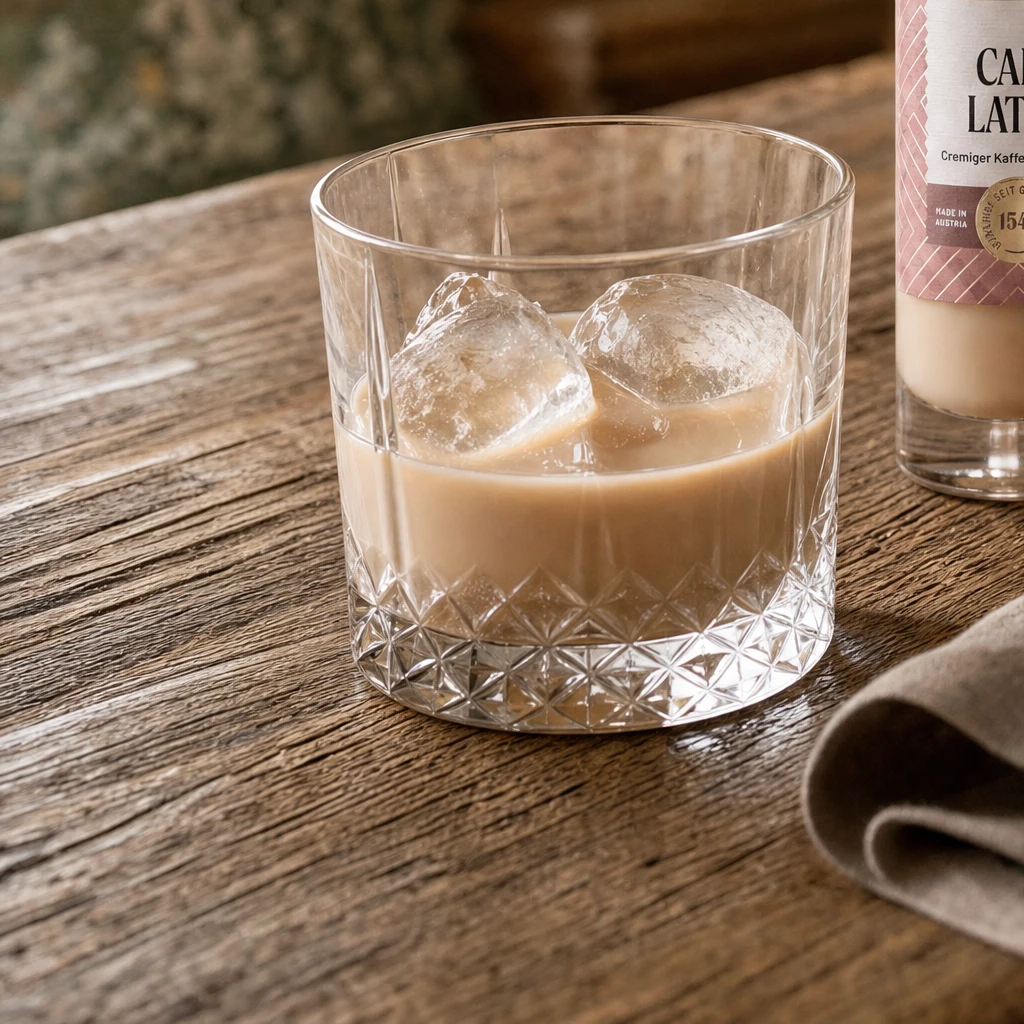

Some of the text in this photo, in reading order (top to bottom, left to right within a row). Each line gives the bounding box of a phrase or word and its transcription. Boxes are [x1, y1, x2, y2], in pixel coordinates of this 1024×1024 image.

[941, 150, 991, 166] Cremiger
[993, 185, 1015, 202] SEIT
[935, 207, 967, 218] MADE IN
[935, 218, 968, 228] AUSTRIA
